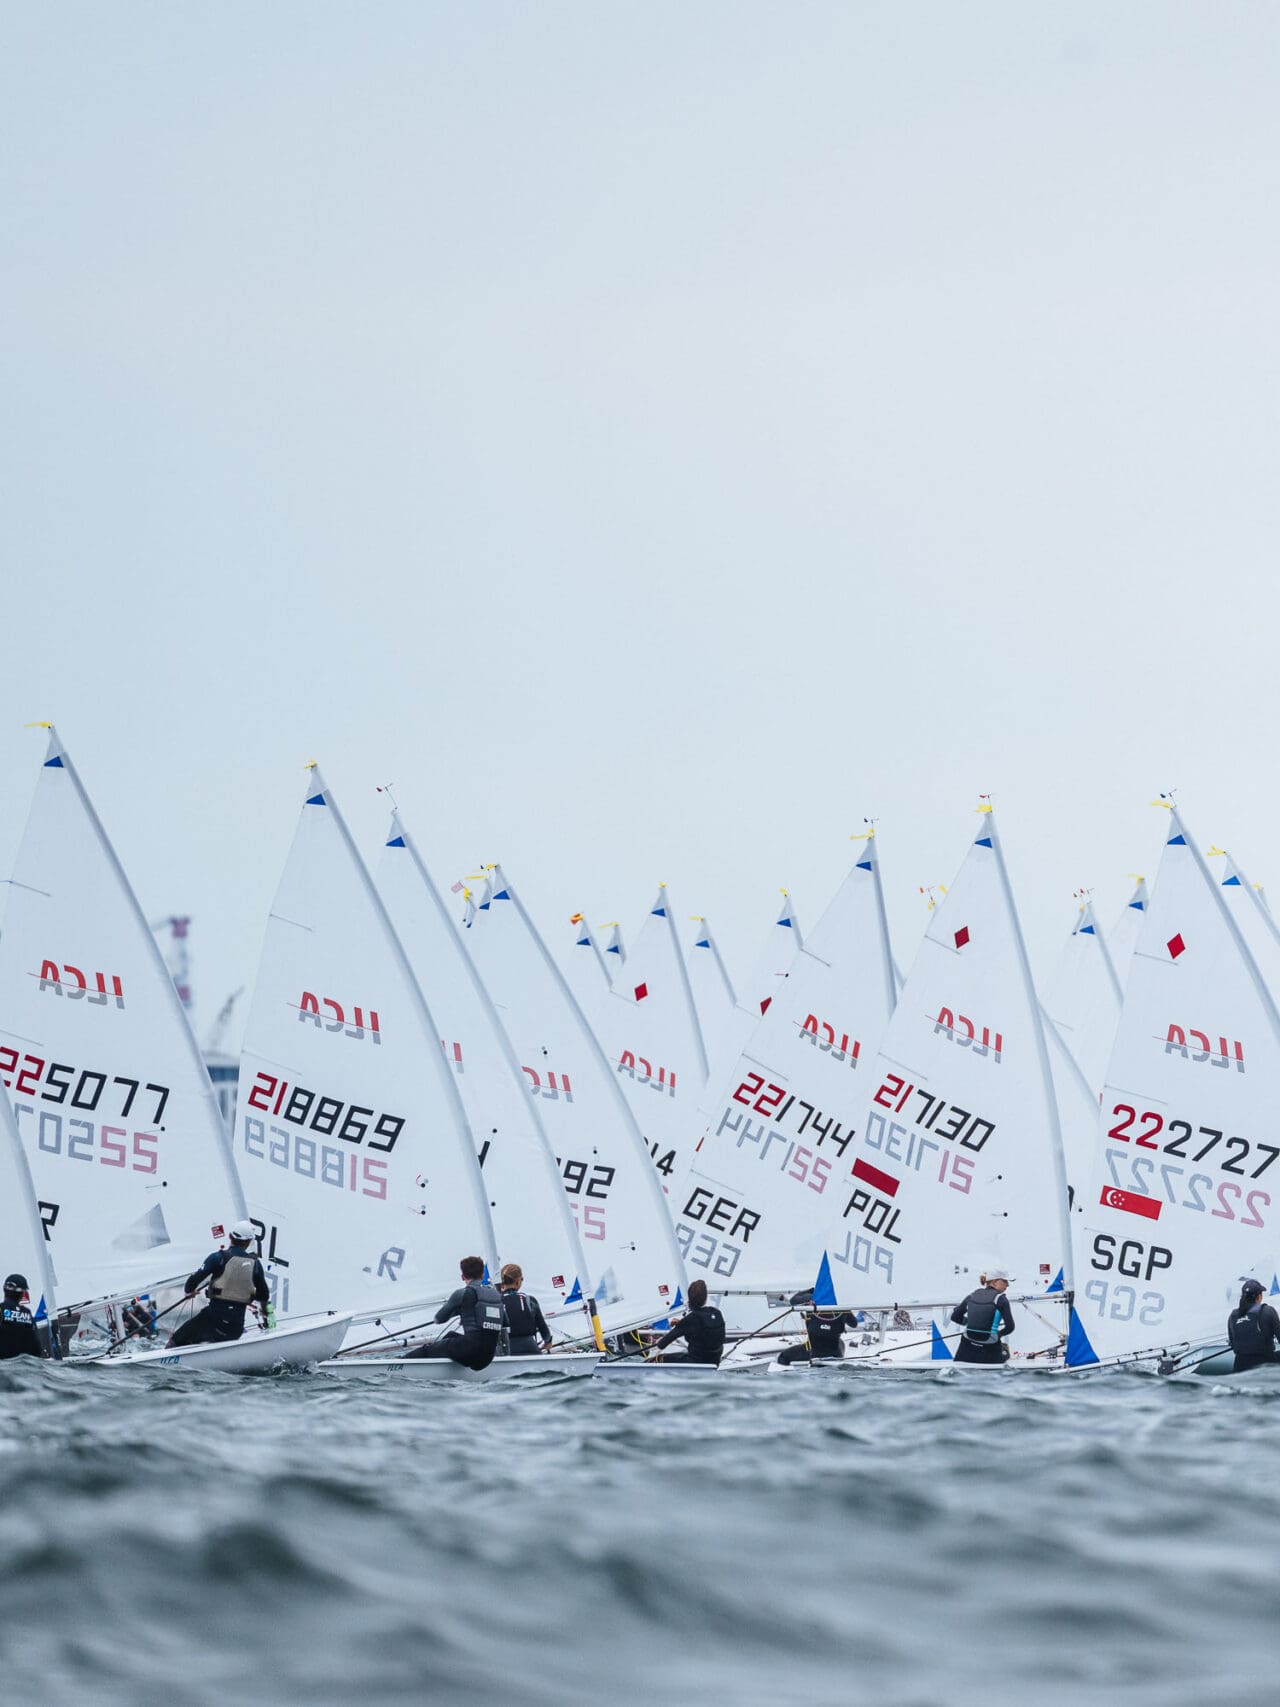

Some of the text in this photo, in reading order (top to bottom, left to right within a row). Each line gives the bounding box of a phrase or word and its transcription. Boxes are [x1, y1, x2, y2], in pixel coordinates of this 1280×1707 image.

[0, 1046, 170, 1124] 225077
[248, 1072, 406, 1152] 218869
[732, 1072, 855, 1157] 221744
[873, 1073, 996, 1152] 217130
[1107, 1103, 1280, 1179] 222727
[682, 1187, 761, 1243] GER
[843, 1188, 902, 1244] POL
[1091, 1234, 1173, 1281] SGP
